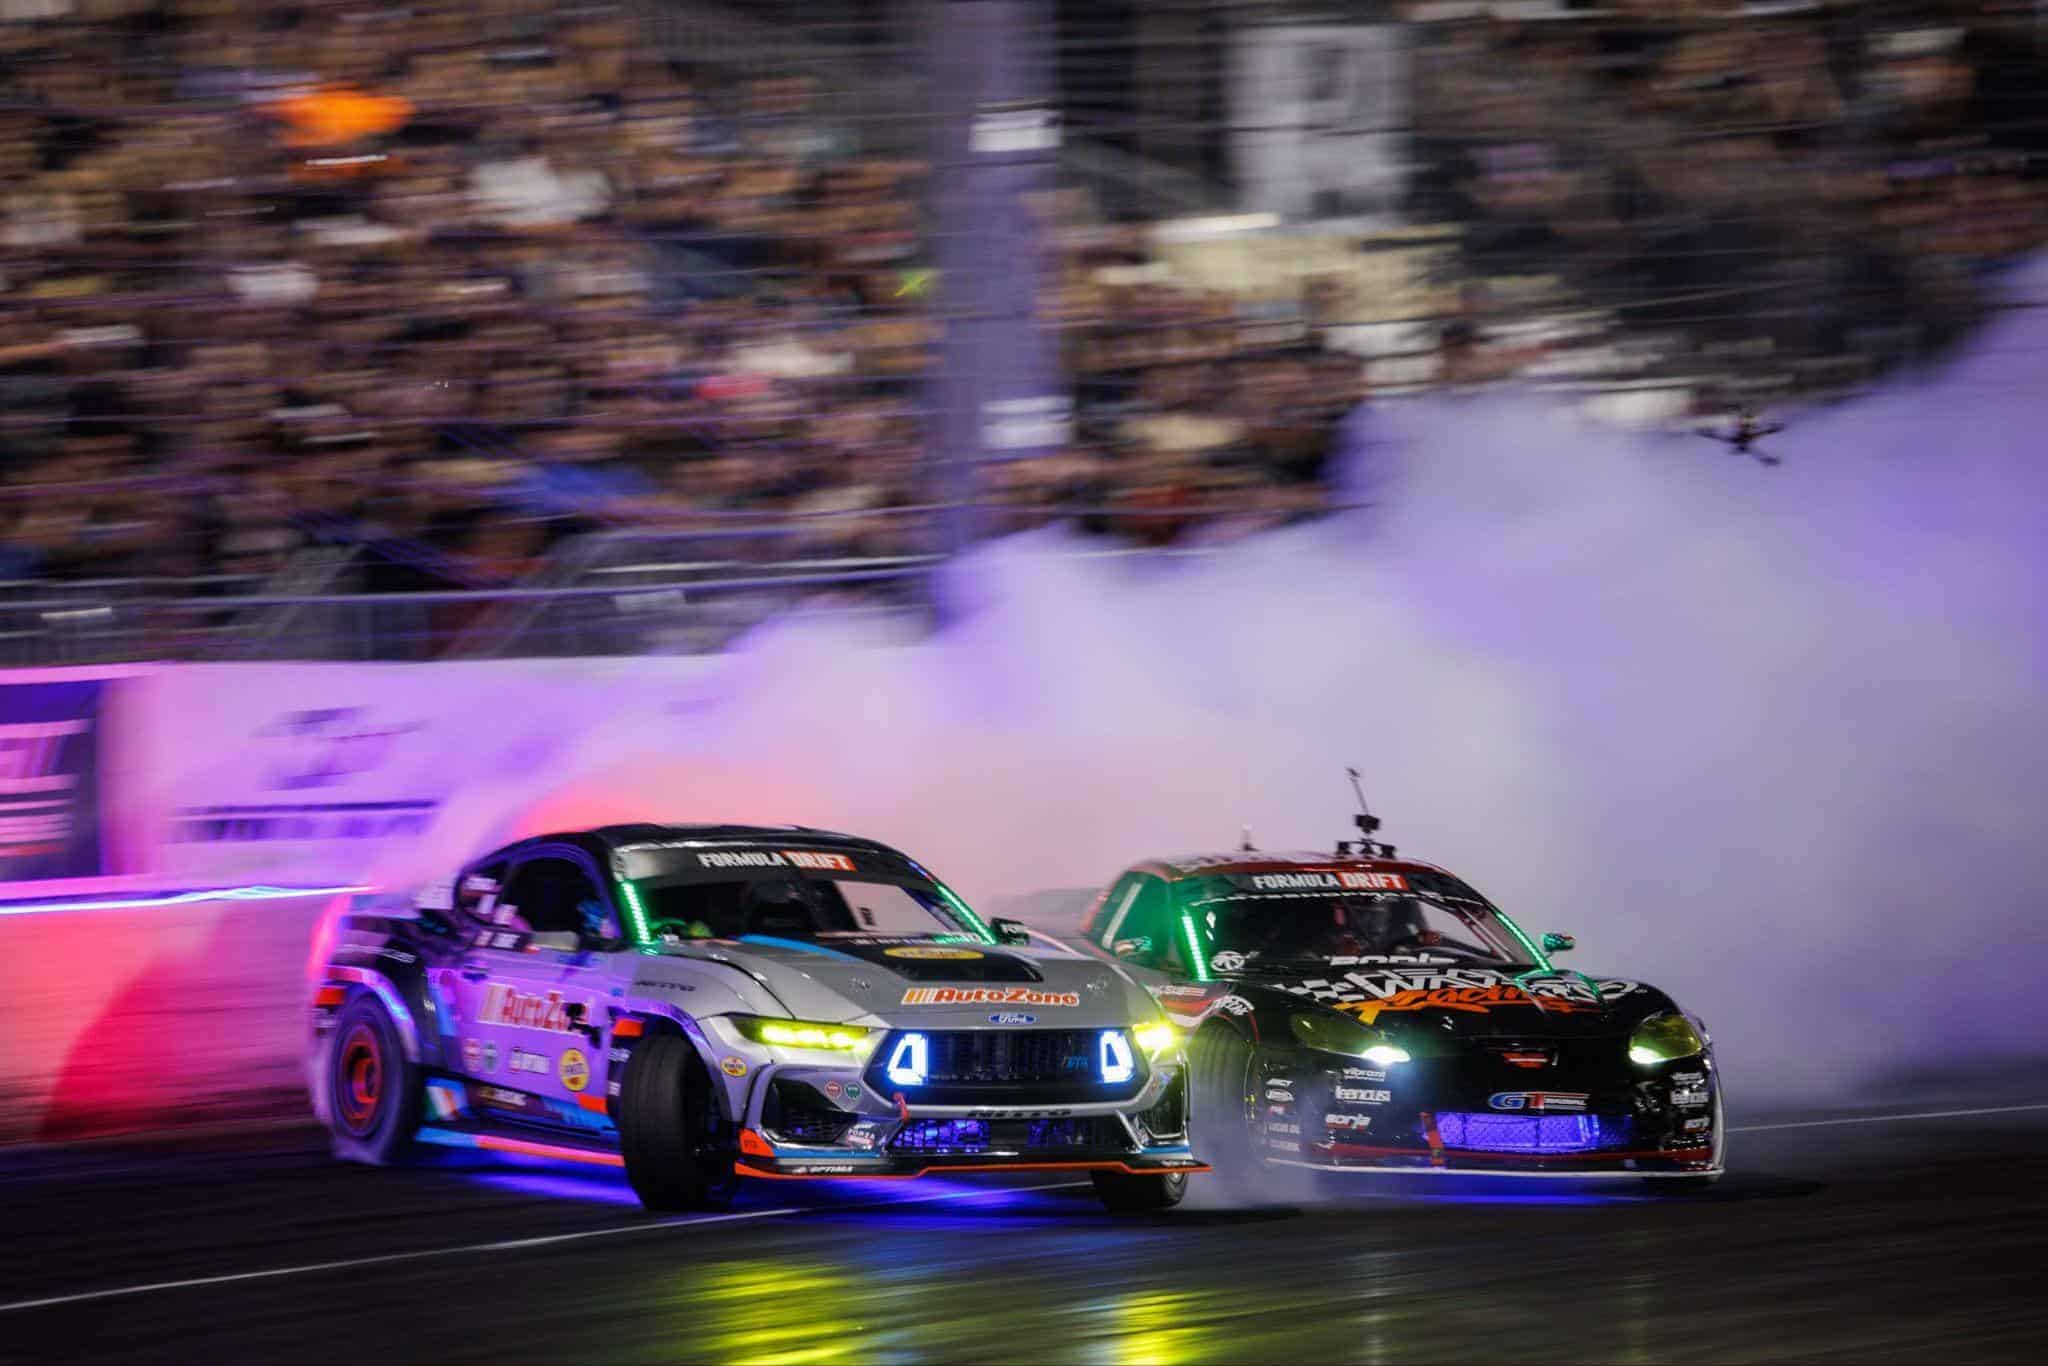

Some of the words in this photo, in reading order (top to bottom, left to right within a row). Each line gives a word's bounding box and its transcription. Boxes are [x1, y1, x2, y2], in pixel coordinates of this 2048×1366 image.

[697, 852, 788, 868] FORMULA
[786, 852, 851, 869] DRIFT
[1253, 873, 1341, 889] FORMULA
[1343, 873, 1404, 889] DRIFT
[933, 986, 1080, 1006] AutoZone
[1488, 1092, 1545, 1110] GT
[848, 1128, 876, 1140] FORZA
